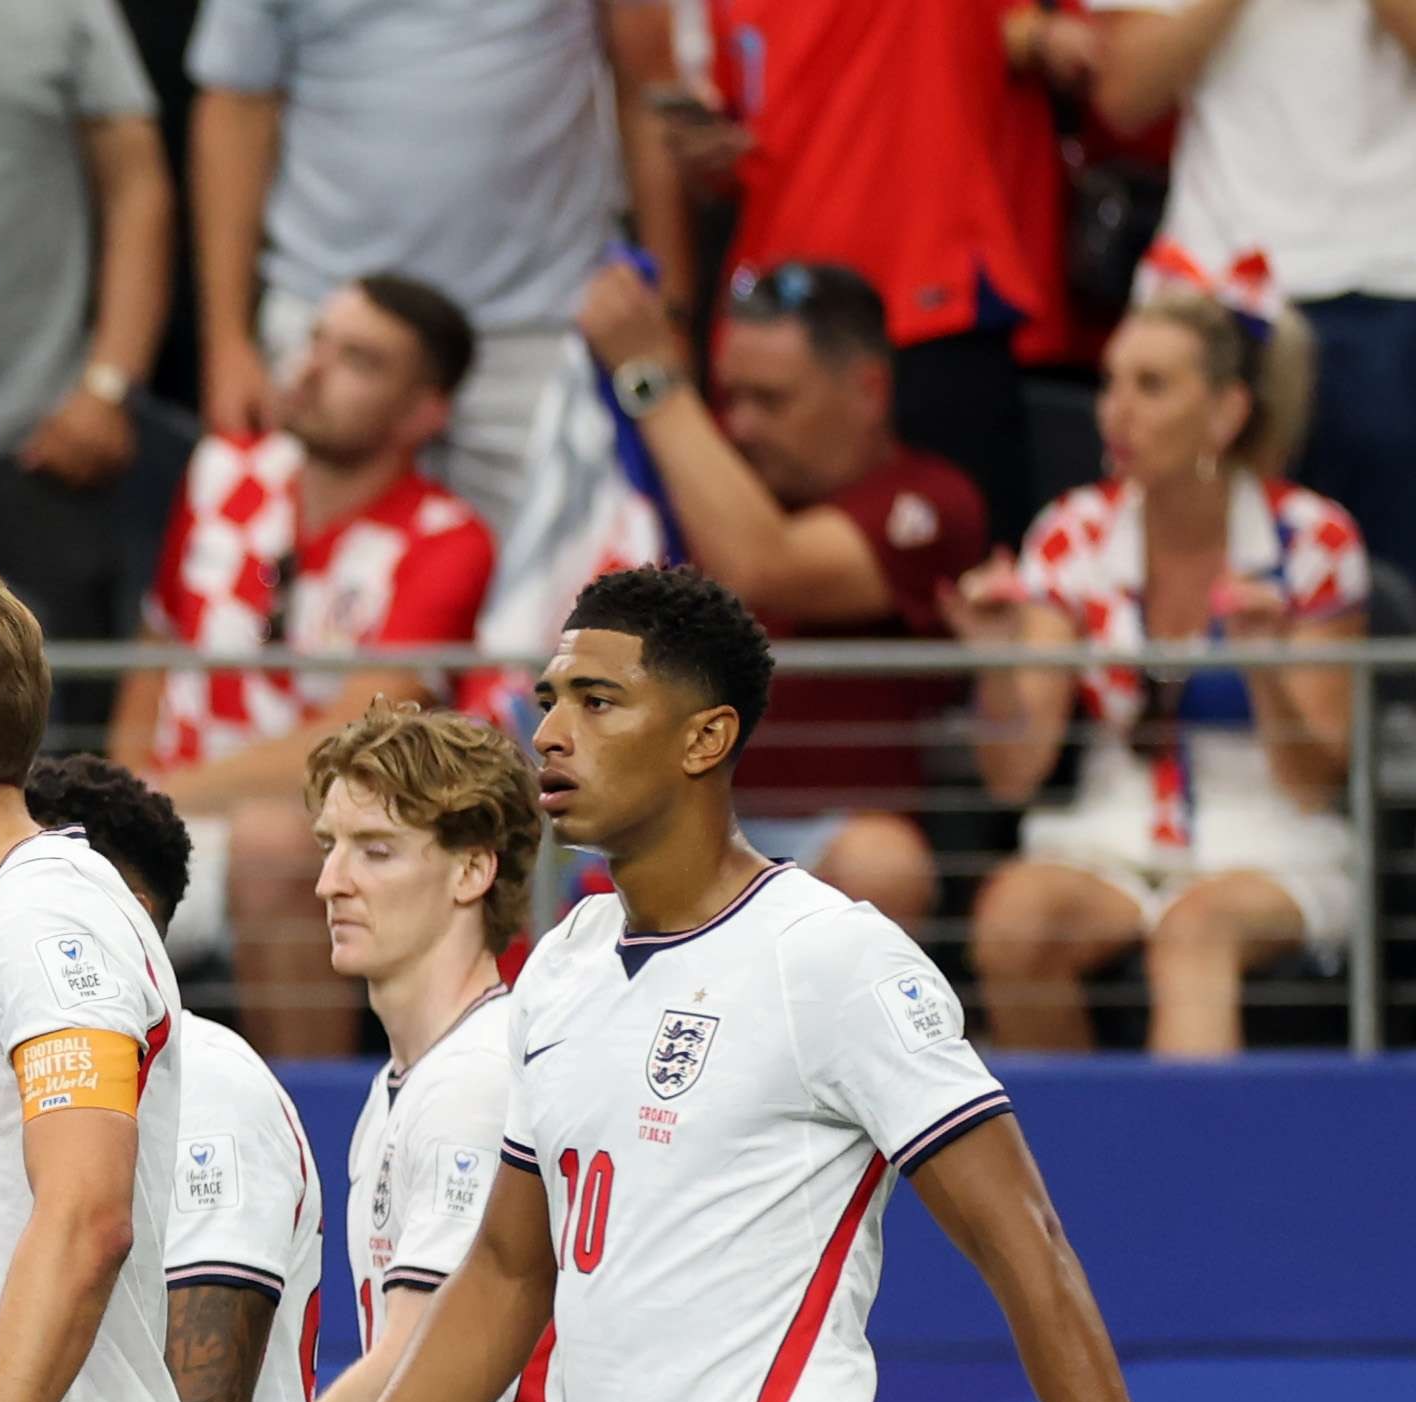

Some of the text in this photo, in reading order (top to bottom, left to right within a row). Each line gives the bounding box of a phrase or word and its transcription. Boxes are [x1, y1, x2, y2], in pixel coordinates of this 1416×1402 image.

[68, 973, 101, 990] PEACE
[23, 1037, 92, 1064] FOOTBALL
[23, 1050, 94, 1083] UNITES
[45, 1070, 99, 1094] World
[41, 1095, 69, 1108] FIFA
[190, 1181, 223, 1197] PEACE
[558, 1148, 615, 1274] 10
